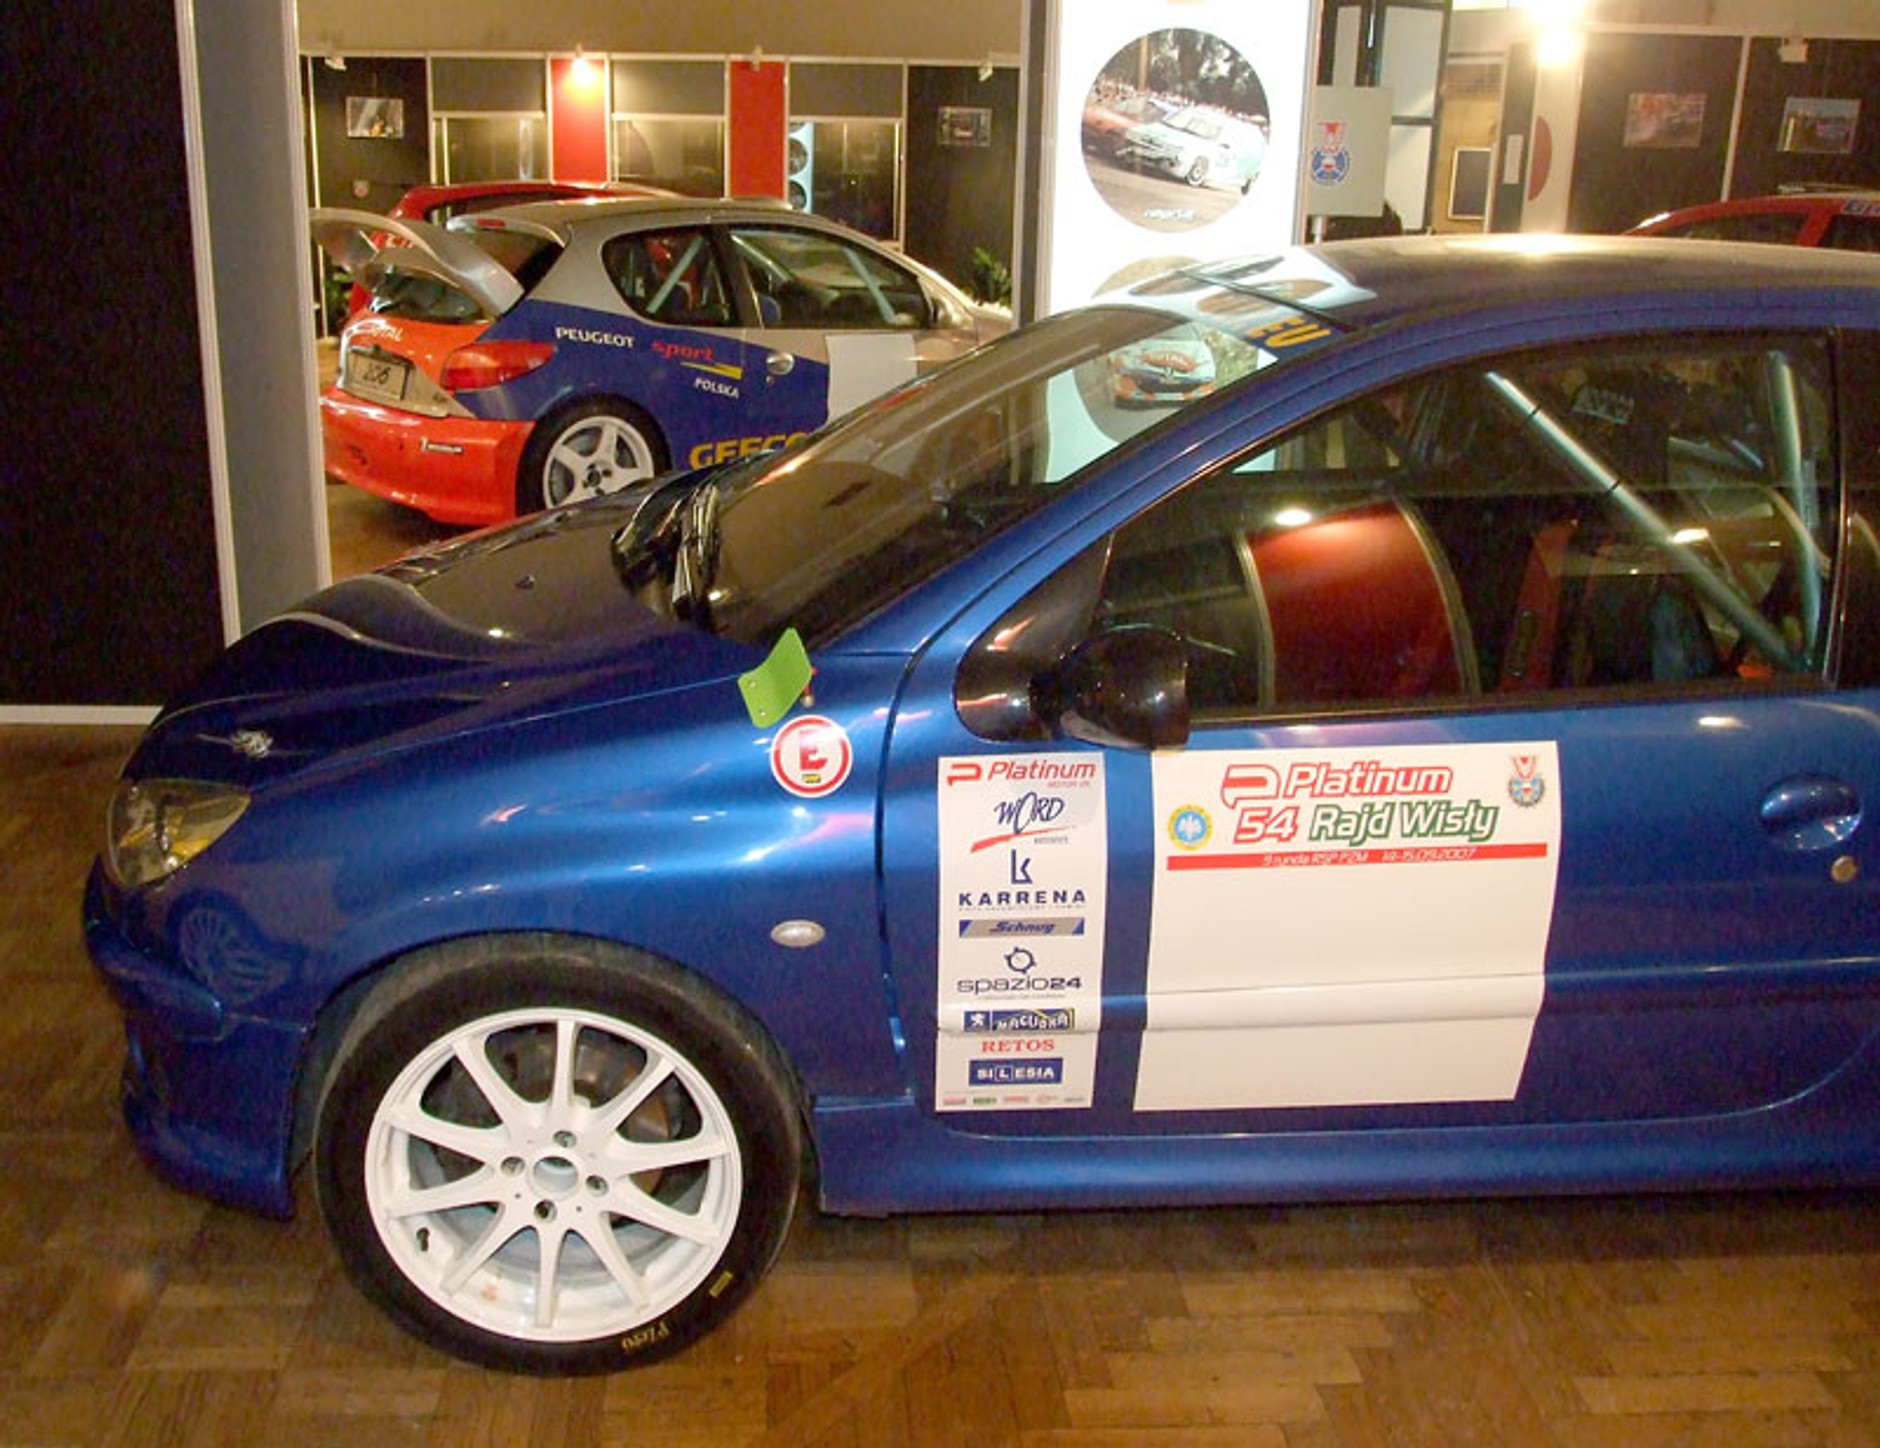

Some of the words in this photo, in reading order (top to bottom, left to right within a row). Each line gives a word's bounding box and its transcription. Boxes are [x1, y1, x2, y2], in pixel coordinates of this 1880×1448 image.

[555, 327, 635, 348] PEUGEOT
[652, 340, 714, 361] sport
[695, 377, 740, 399] POLSKA
[987, 760, 1097, 781] Platinum
[1283, 761, 1453, 799] Platinum
[993, 791, 1065, 835] WORD
[1233, 805, 1300, 844] 54
[1308, 801, 1395, 847] Rajd
[1399, 799, 1500, 843] Wisły
[958, 889, 1086, 907] KARRENA
[956, 975, 1083, 995] spazio24
[981, 1038, 1055, 1054] RETOS
[976, 1066, 1055, 1081] SILESIA
